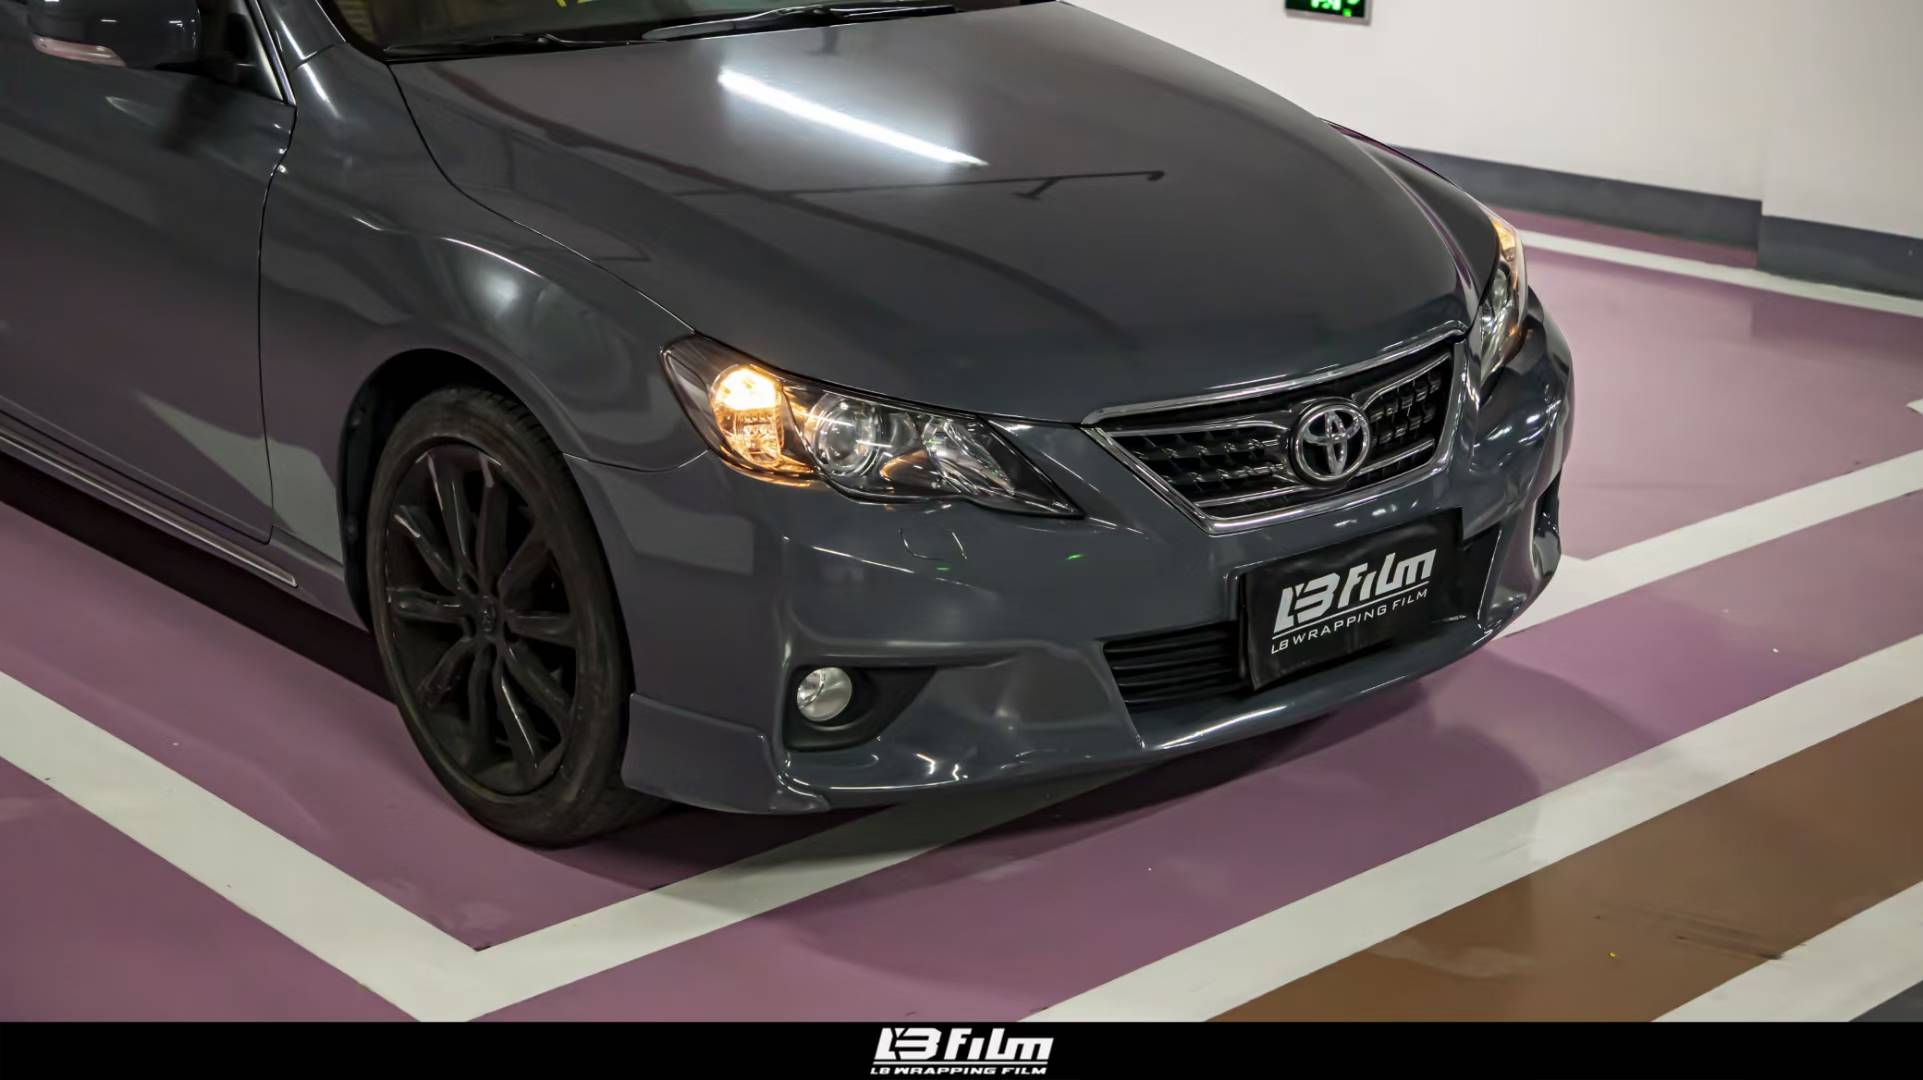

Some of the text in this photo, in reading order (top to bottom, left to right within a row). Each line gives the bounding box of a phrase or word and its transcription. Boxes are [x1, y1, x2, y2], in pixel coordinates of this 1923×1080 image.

[1271, 588, 1428, 655] LB WRAPPING FILM
